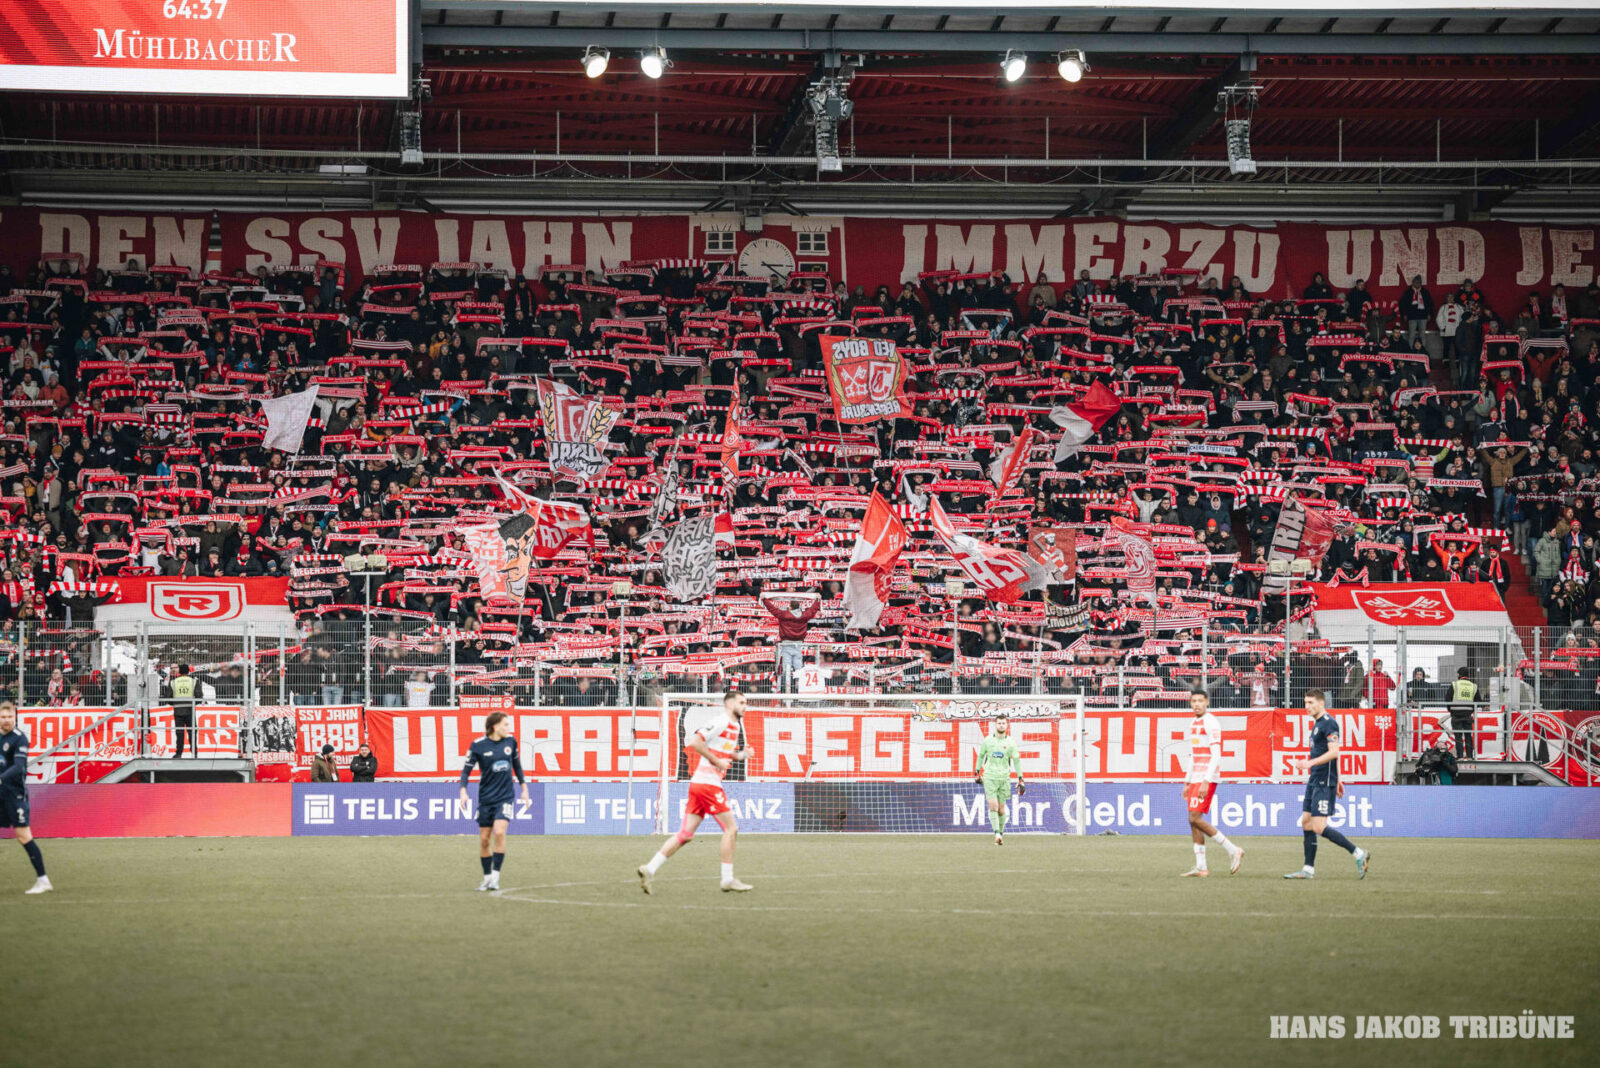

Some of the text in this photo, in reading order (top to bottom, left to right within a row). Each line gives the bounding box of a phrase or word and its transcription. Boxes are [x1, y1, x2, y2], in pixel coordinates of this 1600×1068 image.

[163, 0, 228, 19] 64:37
[93, 28, 299, 62] MÜHLBACHER
[39, 213, 204, 274] DEN
[244, 217, 401, 276] SSV
[1326, 227, 1486, 289] UND
[1429, 478, 1481, 488] REGENSBURG
[804, 672, 819, 687] 24
[178, 688, 189, 697] 147
[299, 708, 359, 720] SSV JAHN
[300, 722, 360, 753] 1889
[392, 715, 661, 773] ULRAS
[342, 798, 533, 820] TELIS FINZ
[953, 794, 1162, 827] Mhr Geld.
[1318, 800, 1329, 815] 15
